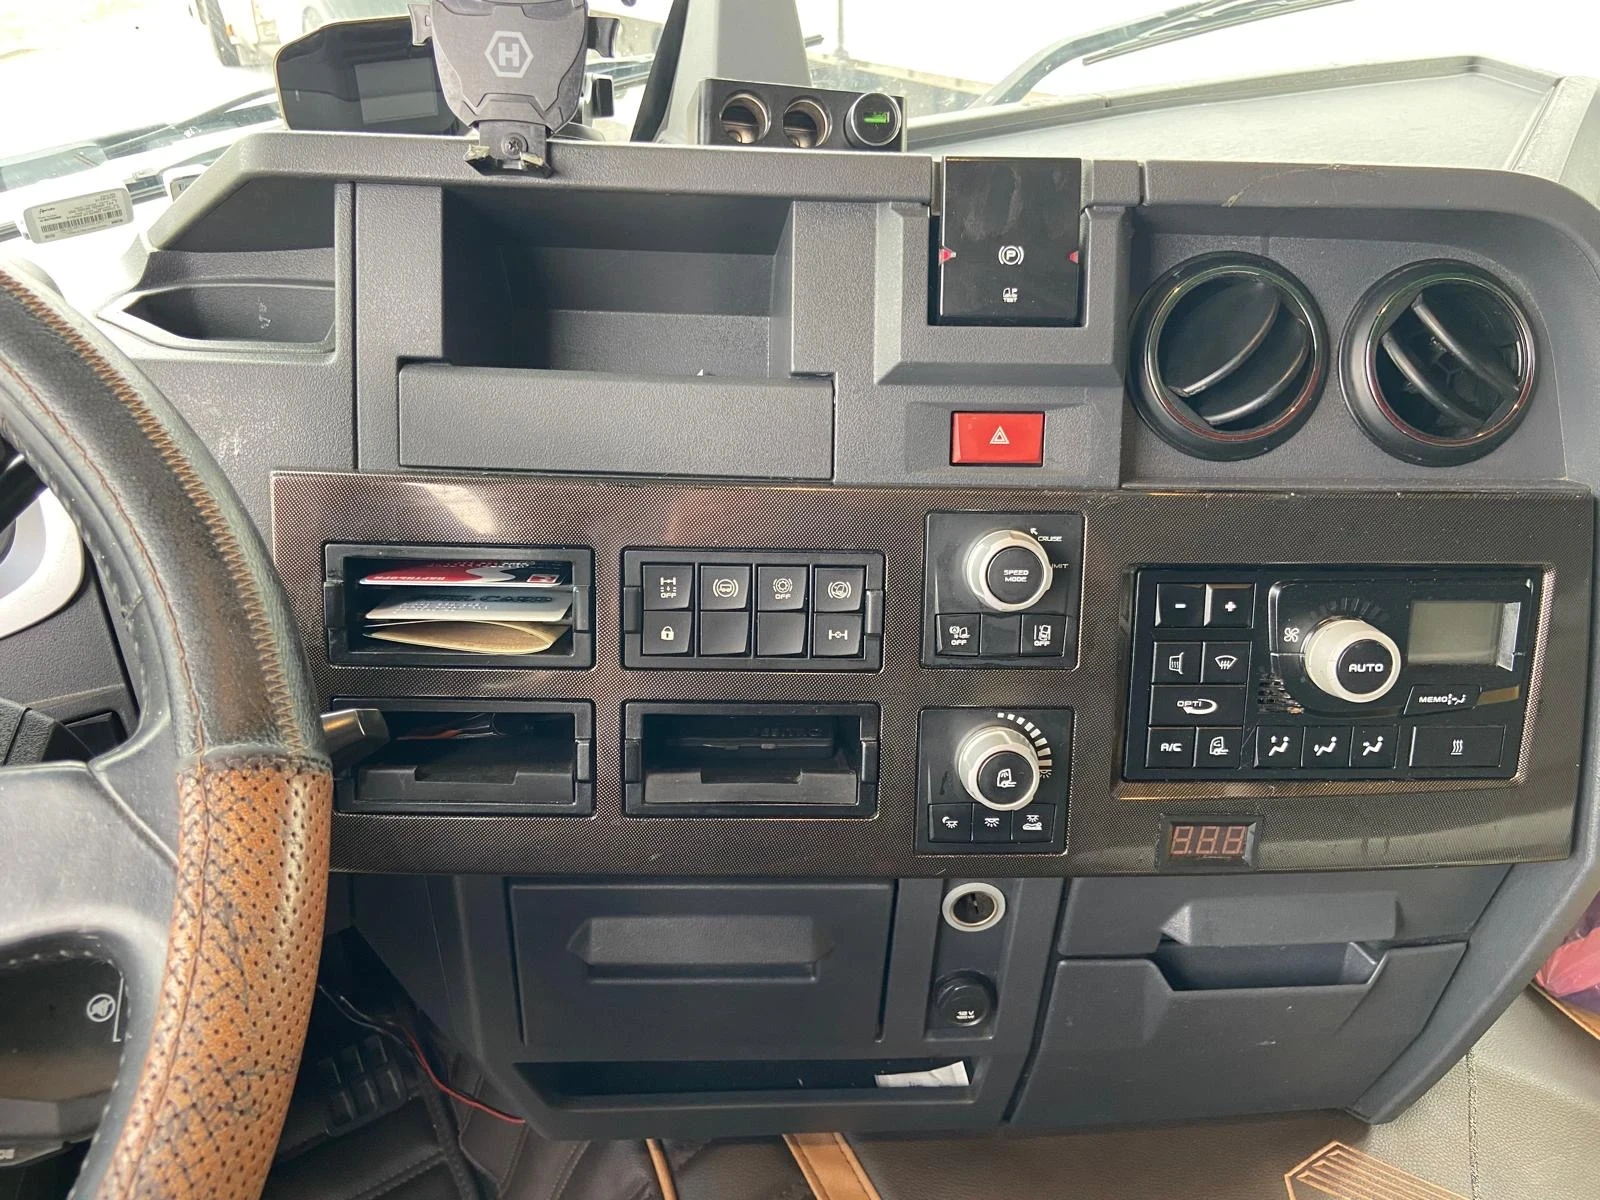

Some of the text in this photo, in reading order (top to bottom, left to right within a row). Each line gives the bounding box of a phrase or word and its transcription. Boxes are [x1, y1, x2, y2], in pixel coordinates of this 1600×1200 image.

[498, 43, 520, 67] H
[1348, 663, 1384, 673] AUTO
[1176, 700, 1202, 708] OPTI
[1418, 696, 1448, 704] MEMO
[1160, 742, 1183, 752] A/C
